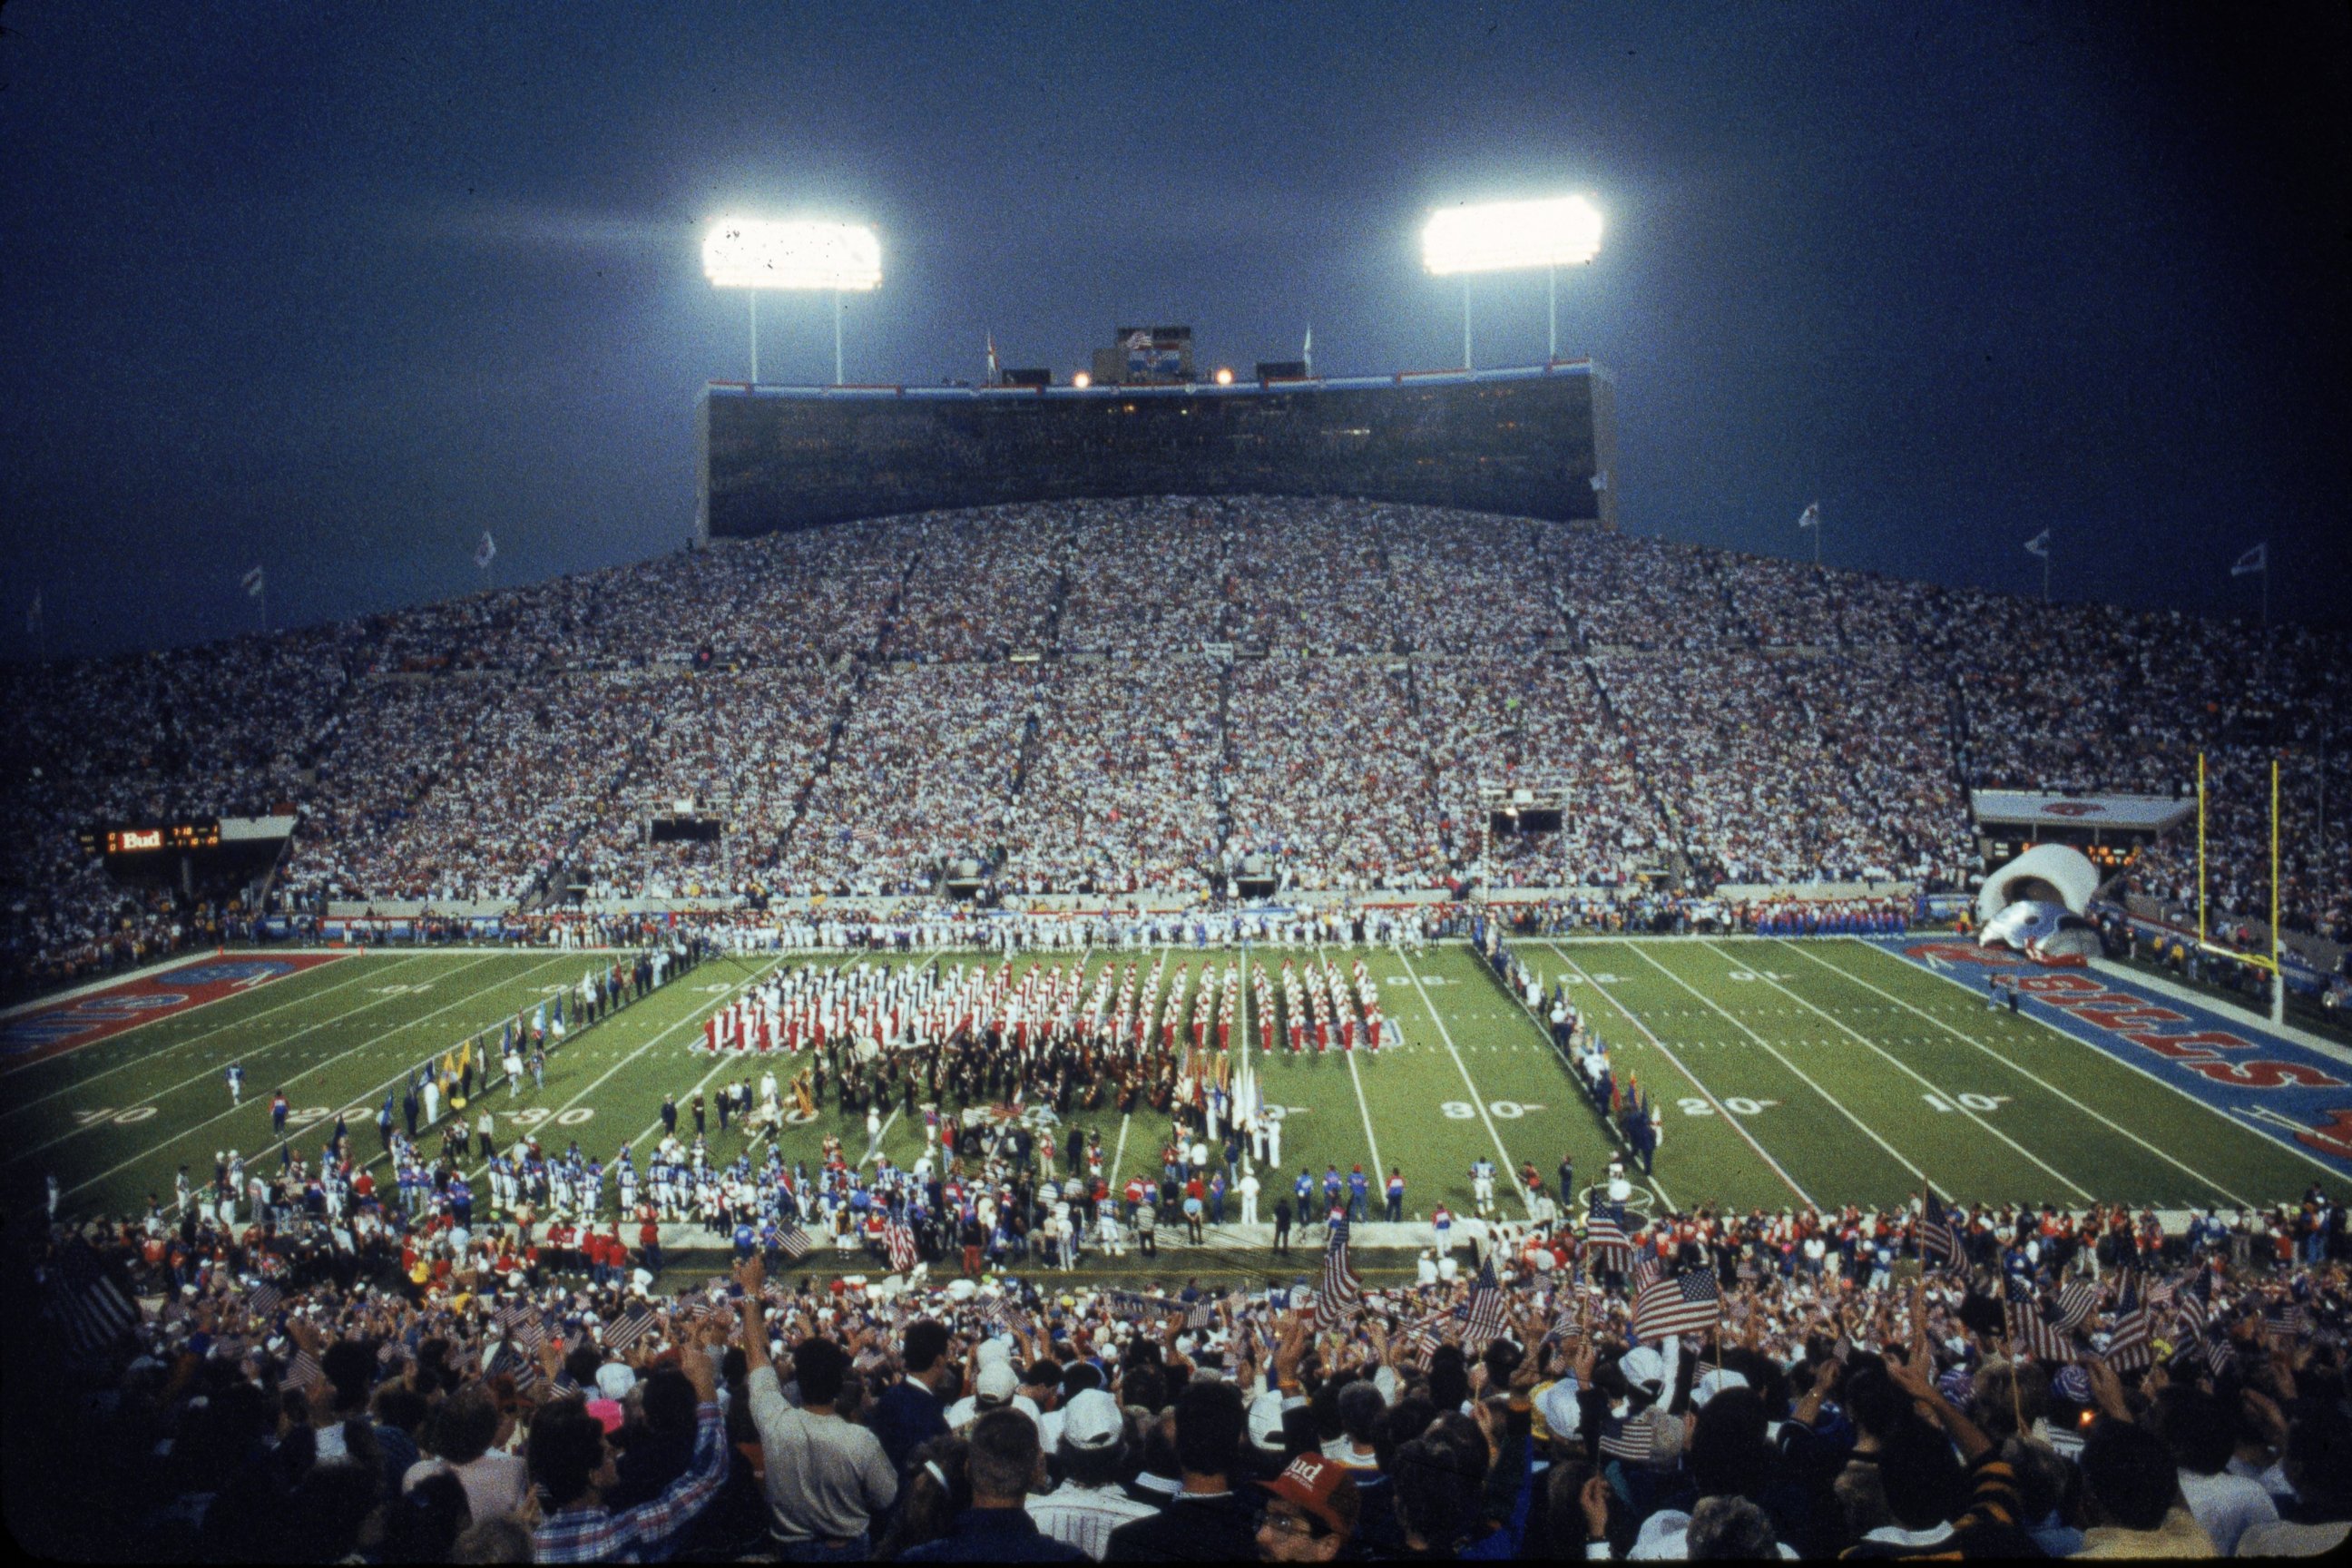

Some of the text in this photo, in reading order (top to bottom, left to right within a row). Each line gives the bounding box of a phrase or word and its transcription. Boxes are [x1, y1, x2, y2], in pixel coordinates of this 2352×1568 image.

[122, 830, 161, 849] Bud
[1984, 974, 2351, 1087] BILLS
[1440, 1101, 1524, 1119] 30
[1677, 1097, 1763, 1115] 20
[1923, 1093, 1999, 1112] 10
[285, 1106, 375, 1124] 20
[511, 1107, 594, 1125] 30
